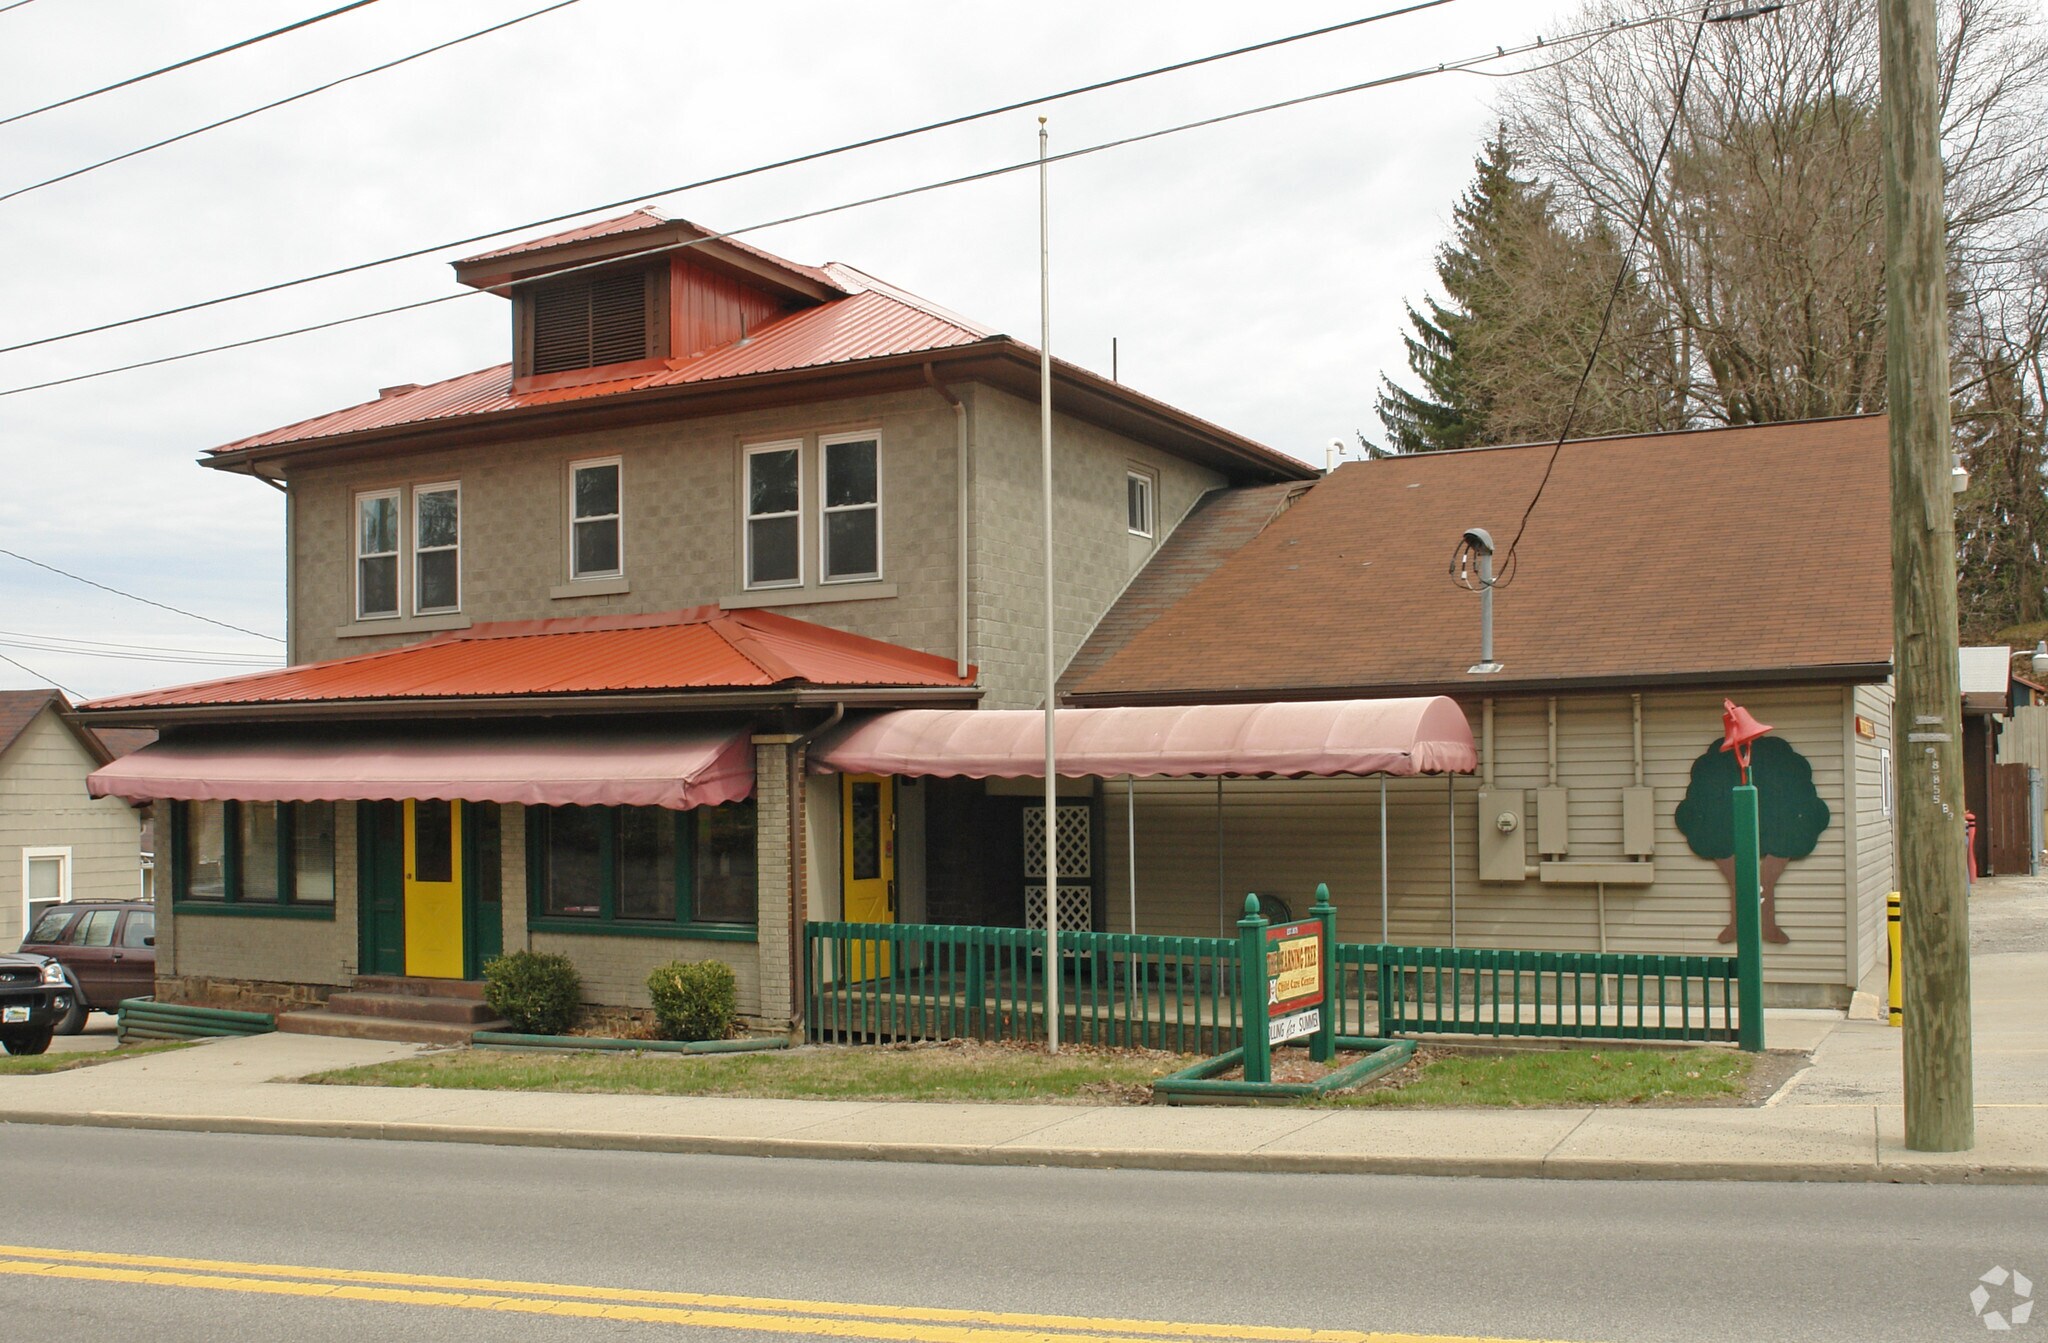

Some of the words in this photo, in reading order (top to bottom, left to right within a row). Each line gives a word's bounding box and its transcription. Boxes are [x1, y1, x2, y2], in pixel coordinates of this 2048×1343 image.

[1278, 948, 1304, 973] LEARNING
[1304, 945, 1317, 968] TREE
[1278, 980, 1290, 993] Child
[1291, 979, 1301, 989] Care
[1301, 976, 1316, 987] Center
